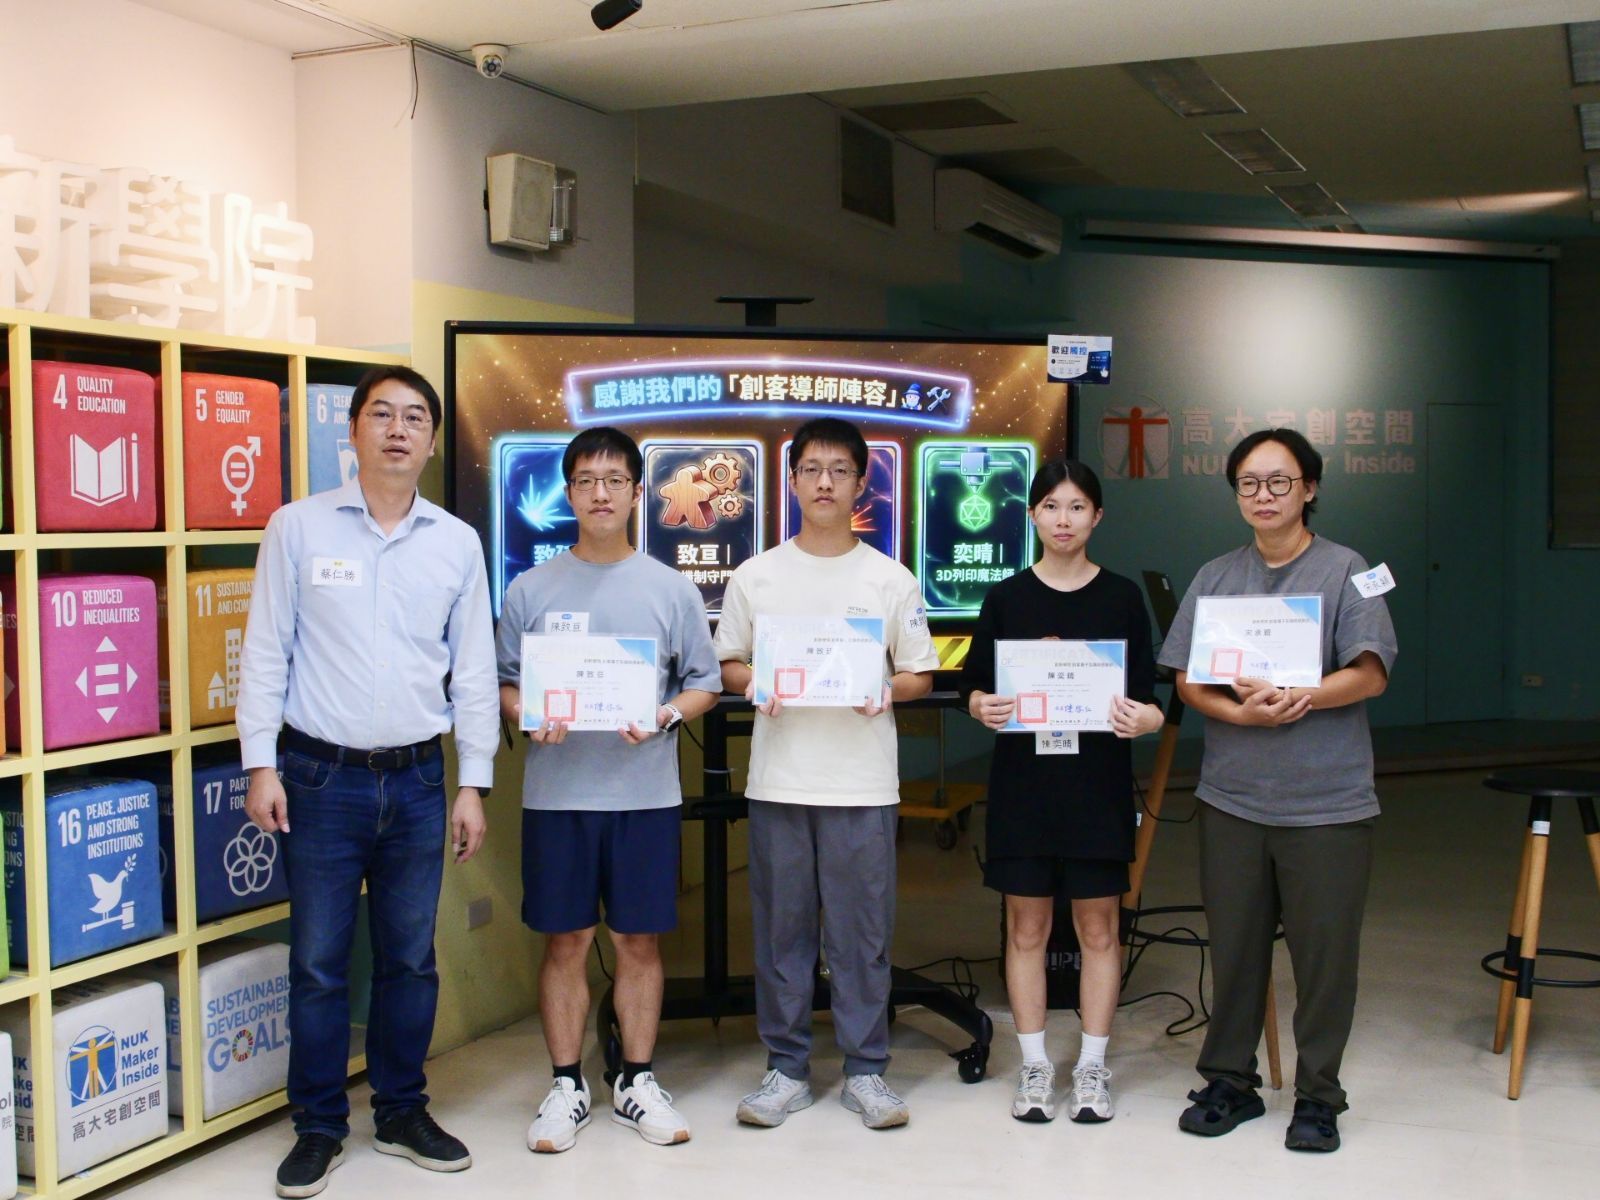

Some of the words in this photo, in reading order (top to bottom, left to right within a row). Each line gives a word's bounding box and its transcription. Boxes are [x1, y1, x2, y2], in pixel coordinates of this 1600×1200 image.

[53, 374, 69, 410] 4
[77, 376, 113, 394] QUALITY
[77, 396, 126, 415] EDUCATION
[195, 388, 208, 422] 5
[215, 390, 245, 406] GENDER
[316, 393, 328, 424] 6
[215, 408, 251, 424] EQUALITY
[1343, 450, 1416, 475] Inside
[82, 589, 123, 607] REDUCED
[195, 584, 212, 618] 11
[216, 580, 254, 598] SUSTAINA
[51, 591, 77, 628] 10
[83, 607, 140, 626] INEQUALITIES
[217, 600, 233, 615] AND
[229, 774, 252, 793] PART
[117, 792, 151, 813] JUSTICE
[203, 781, 223, 815] 17
[57, 808, 82, 848] 16
[87, 823, 106, 841] AND
[106, 817, 140, 837] STRONG
[87, 834, 144, 860] INSTITUTIONS
[207, 975, 290, 1018] SUSTAINABL
[206, 995, 289, 1039] DEVELOPMEN
[120, 1029, 149, 1050] NUK
[121, 1046, 160, 1070] Maker
[122, 1062, 160, 1087] Inside
[72, 1088, 161, 1142] 高大宅創空間
